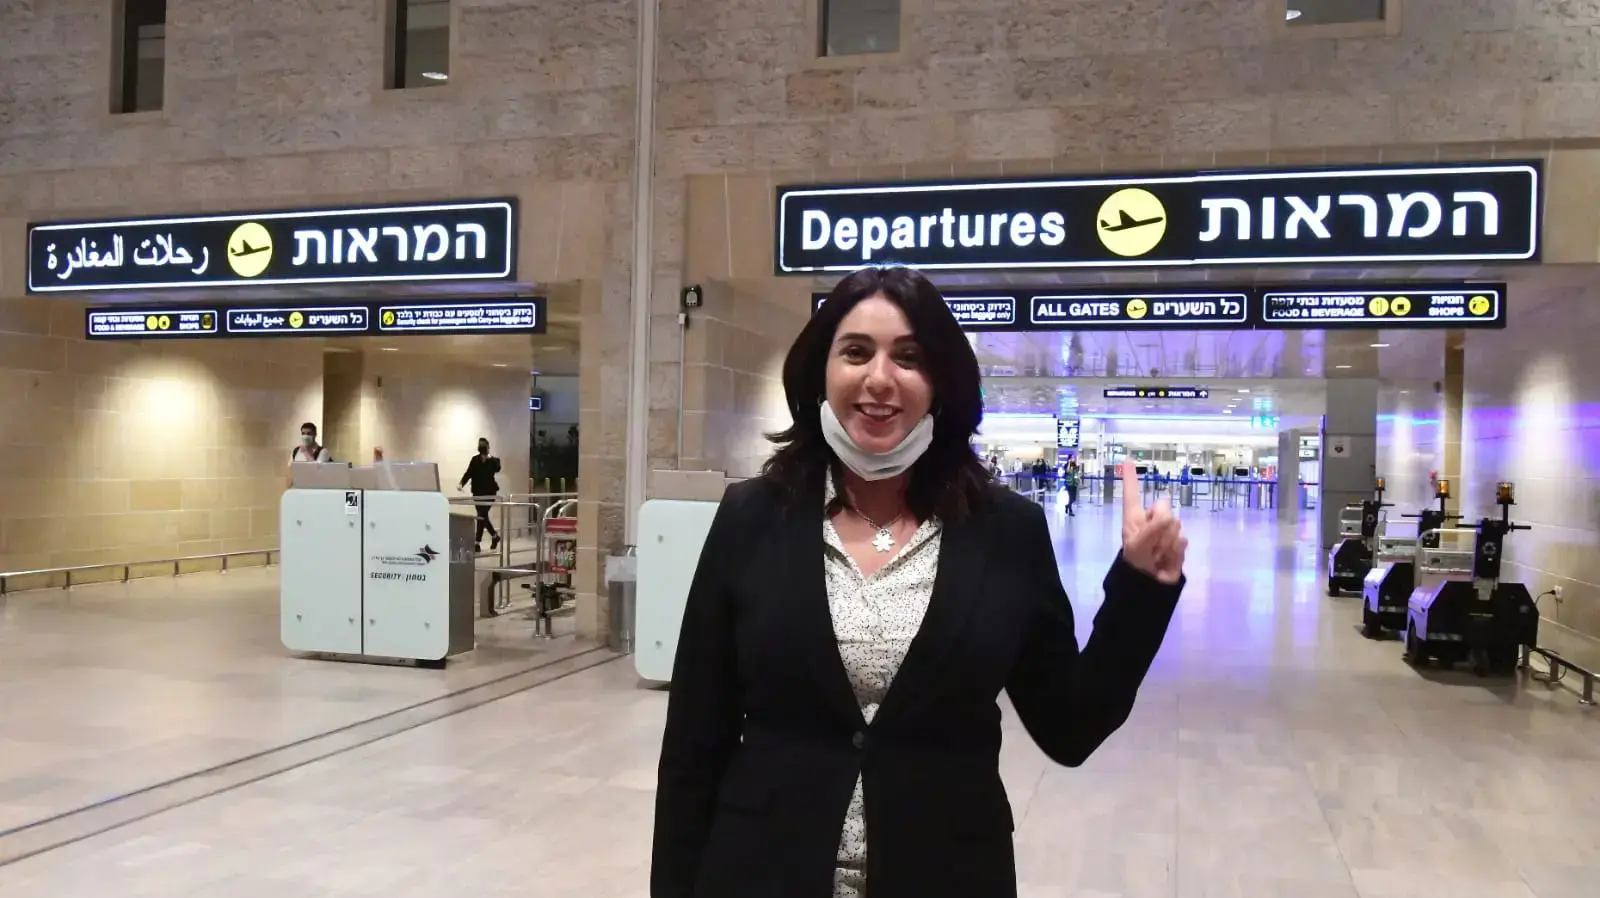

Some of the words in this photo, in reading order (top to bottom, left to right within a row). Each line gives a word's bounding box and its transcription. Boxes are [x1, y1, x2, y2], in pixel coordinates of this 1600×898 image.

[1199, 192, 1498, 241] המראות
[802, 208, 1065, 260] Departures
[292, 223, 486, 265] המראות
[47, 234, 123, 279] المغادرة
[134, 234, 208, 274] رحلات
[1037, 304, 1066, 316] ALL
[1069, 303, 1119, 316] GATES
[1153, 302, 1215, 316] השערים
[1217, 296, 1240, 314] כל
[1429, 307, 1464, 316] SHOPS
[350, 313, 362, 323] כל
[996, 310, 1011, 320] only
[1272, 308, 1300, 318] FOOD
[1310, 307, 1365, 317] BEVERAGE
[309, 315, 348, 325] השערים
[370, 572, 401, 580] SECURITY
